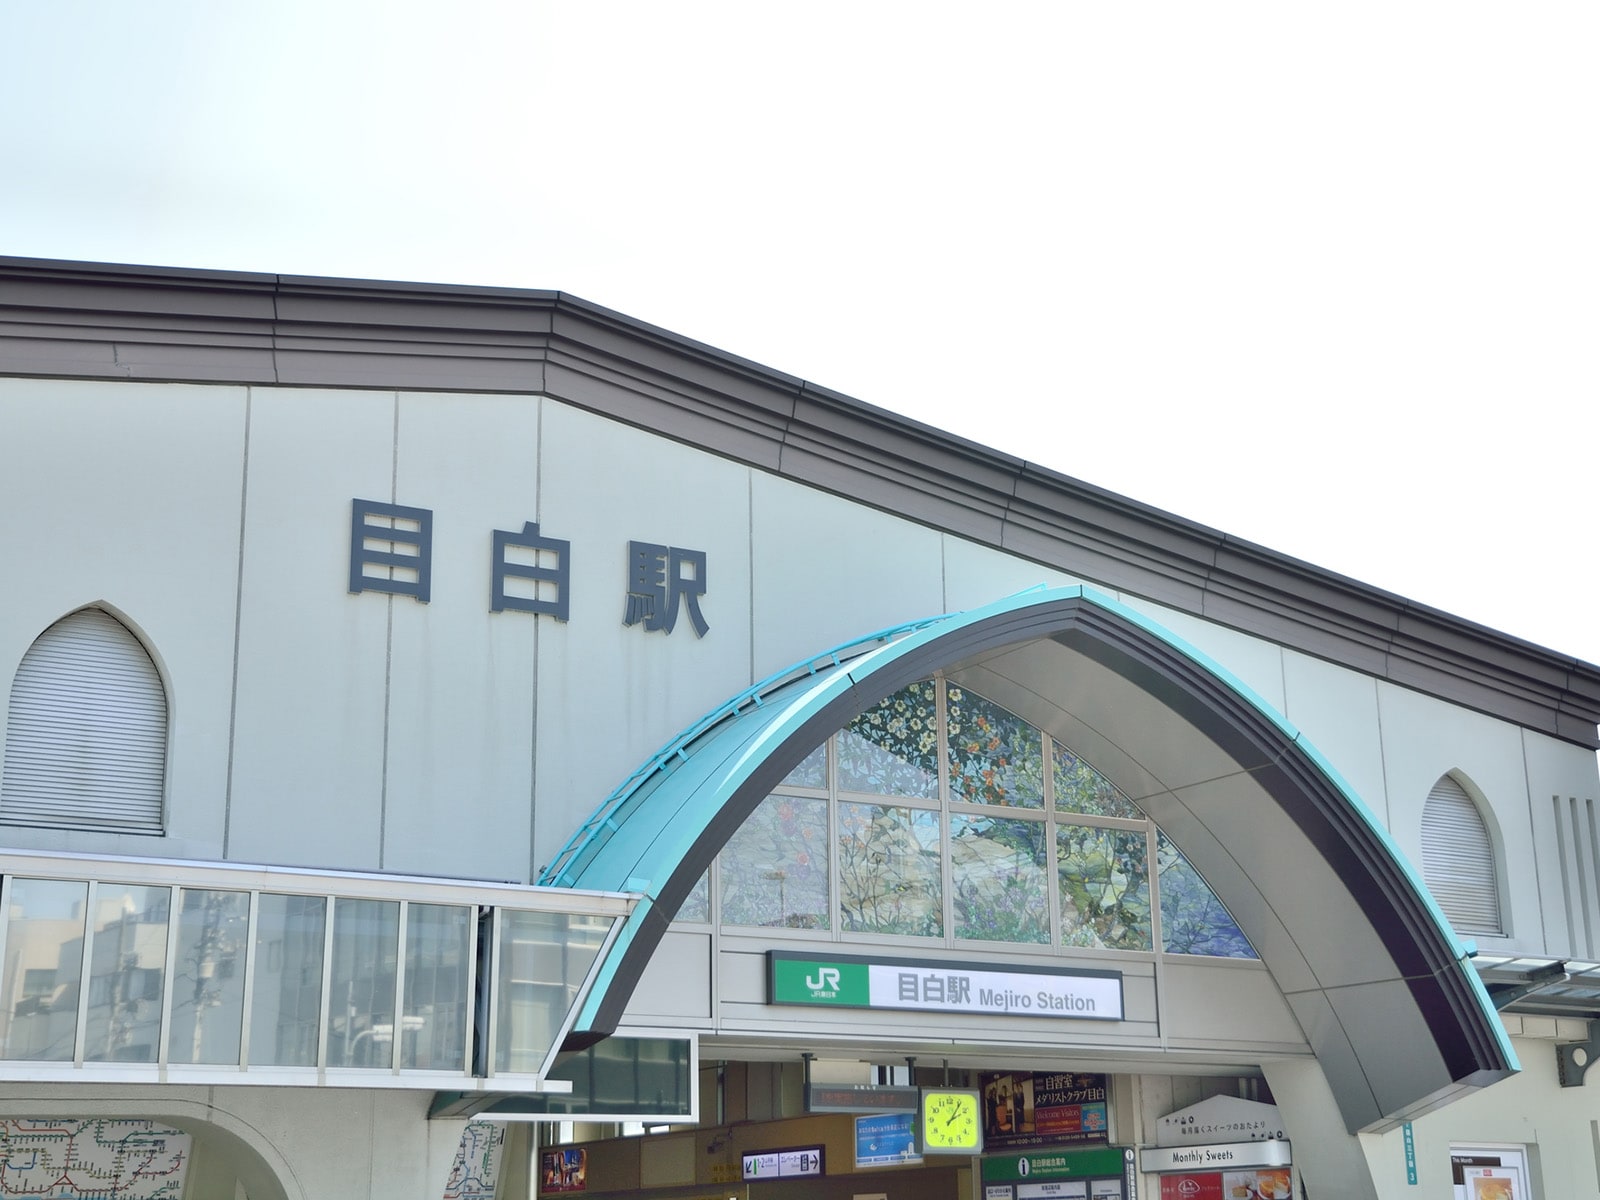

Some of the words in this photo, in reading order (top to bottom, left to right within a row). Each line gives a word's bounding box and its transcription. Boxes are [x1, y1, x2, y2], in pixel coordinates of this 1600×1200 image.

[348, 498, 710, 640] 目白駅
[806, 967, 841, 991] JR
[898, 972, 970, 1005] 目白駅
[979, 988, 1031, 1013] Mejiro
[1037, 992, 1096, 1012] Station
[1045, 1074, 1074, 1090] 自習室
[1035, 1087, 1105, 1105] メダリストクラブ目白
[1172, 1149, 1203, 1164] Monthly
[1206, 1149, 1234, 1161] Sweets
